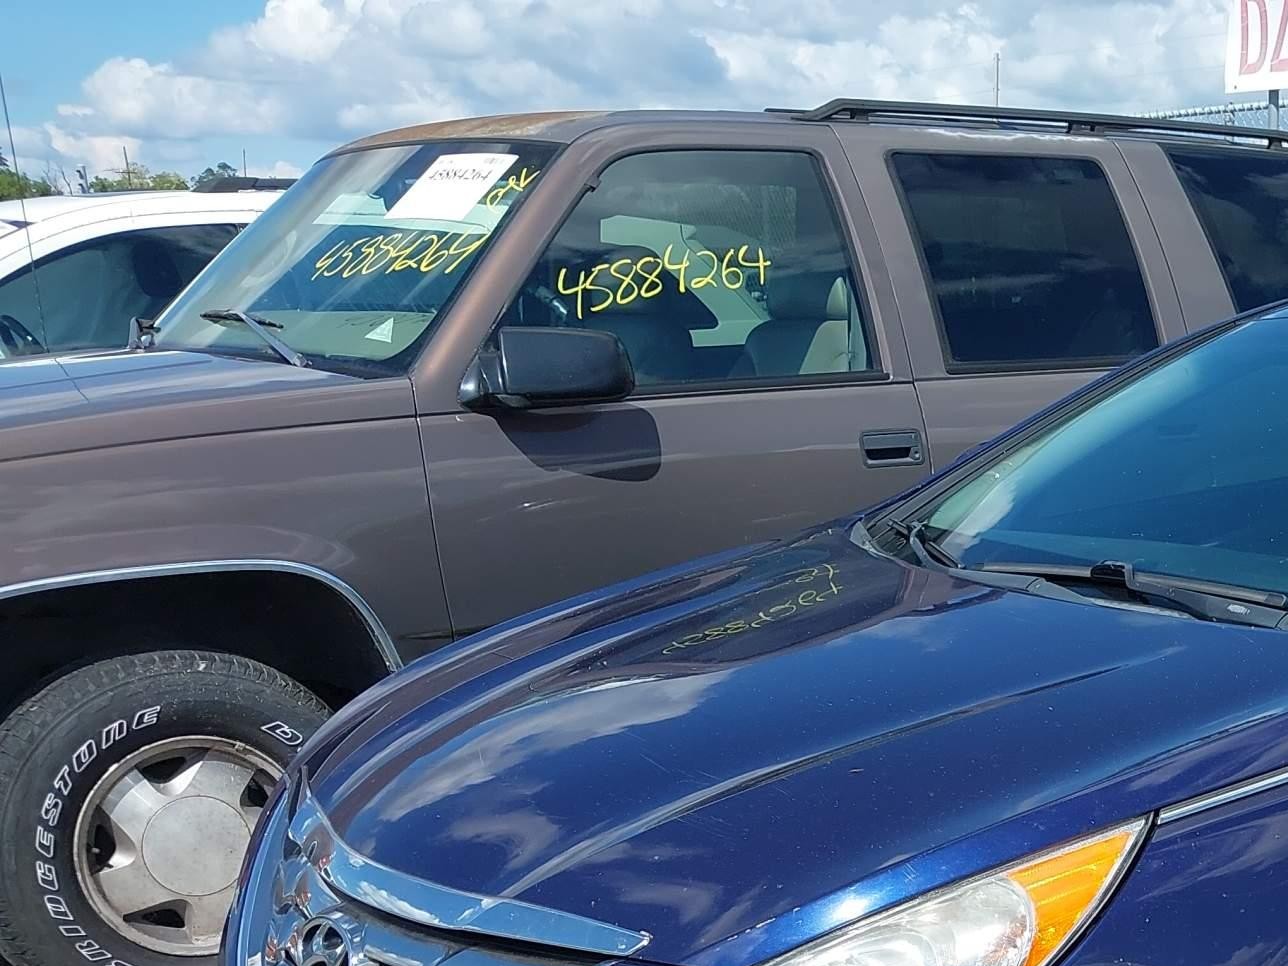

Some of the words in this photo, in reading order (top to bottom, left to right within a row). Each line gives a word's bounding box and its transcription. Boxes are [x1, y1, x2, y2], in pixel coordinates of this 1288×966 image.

[311, 228, 491, 281] 45884264
[557, 244, 772, 320] 45884264
[260, 720, 304, 748] D
